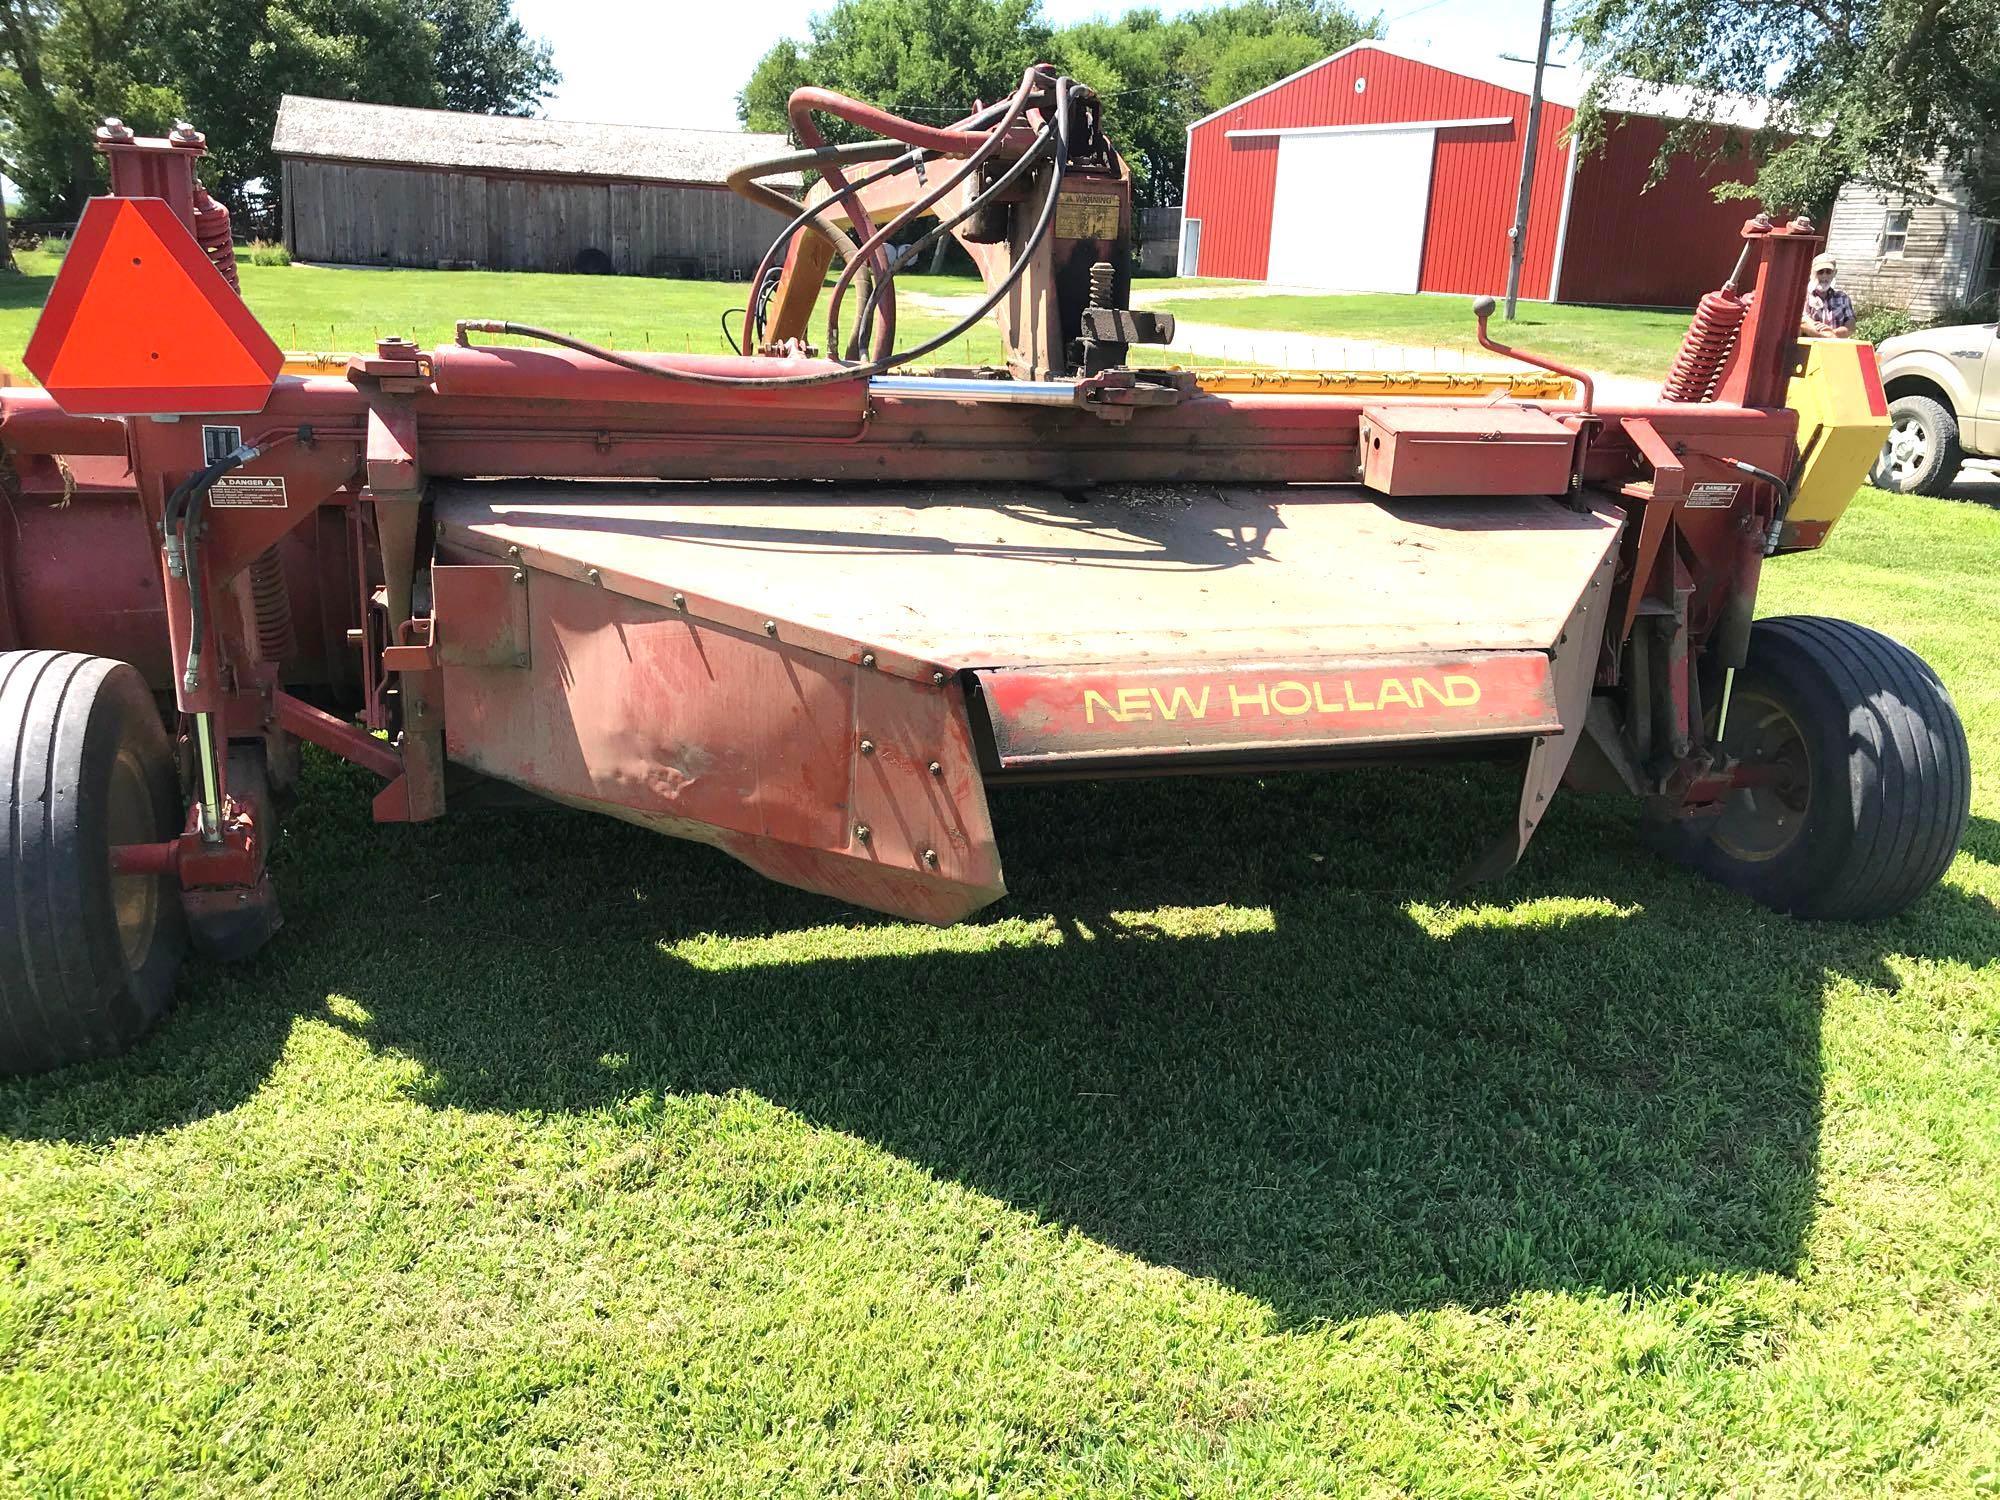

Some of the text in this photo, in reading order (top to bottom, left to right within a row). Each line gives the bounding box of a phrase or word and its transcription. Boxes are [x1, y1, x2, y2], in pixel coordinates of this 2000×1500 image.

[1076, 195, 1112, 204] WARNING
[1084, 675, 1481, 724] NEW HOLLAND
